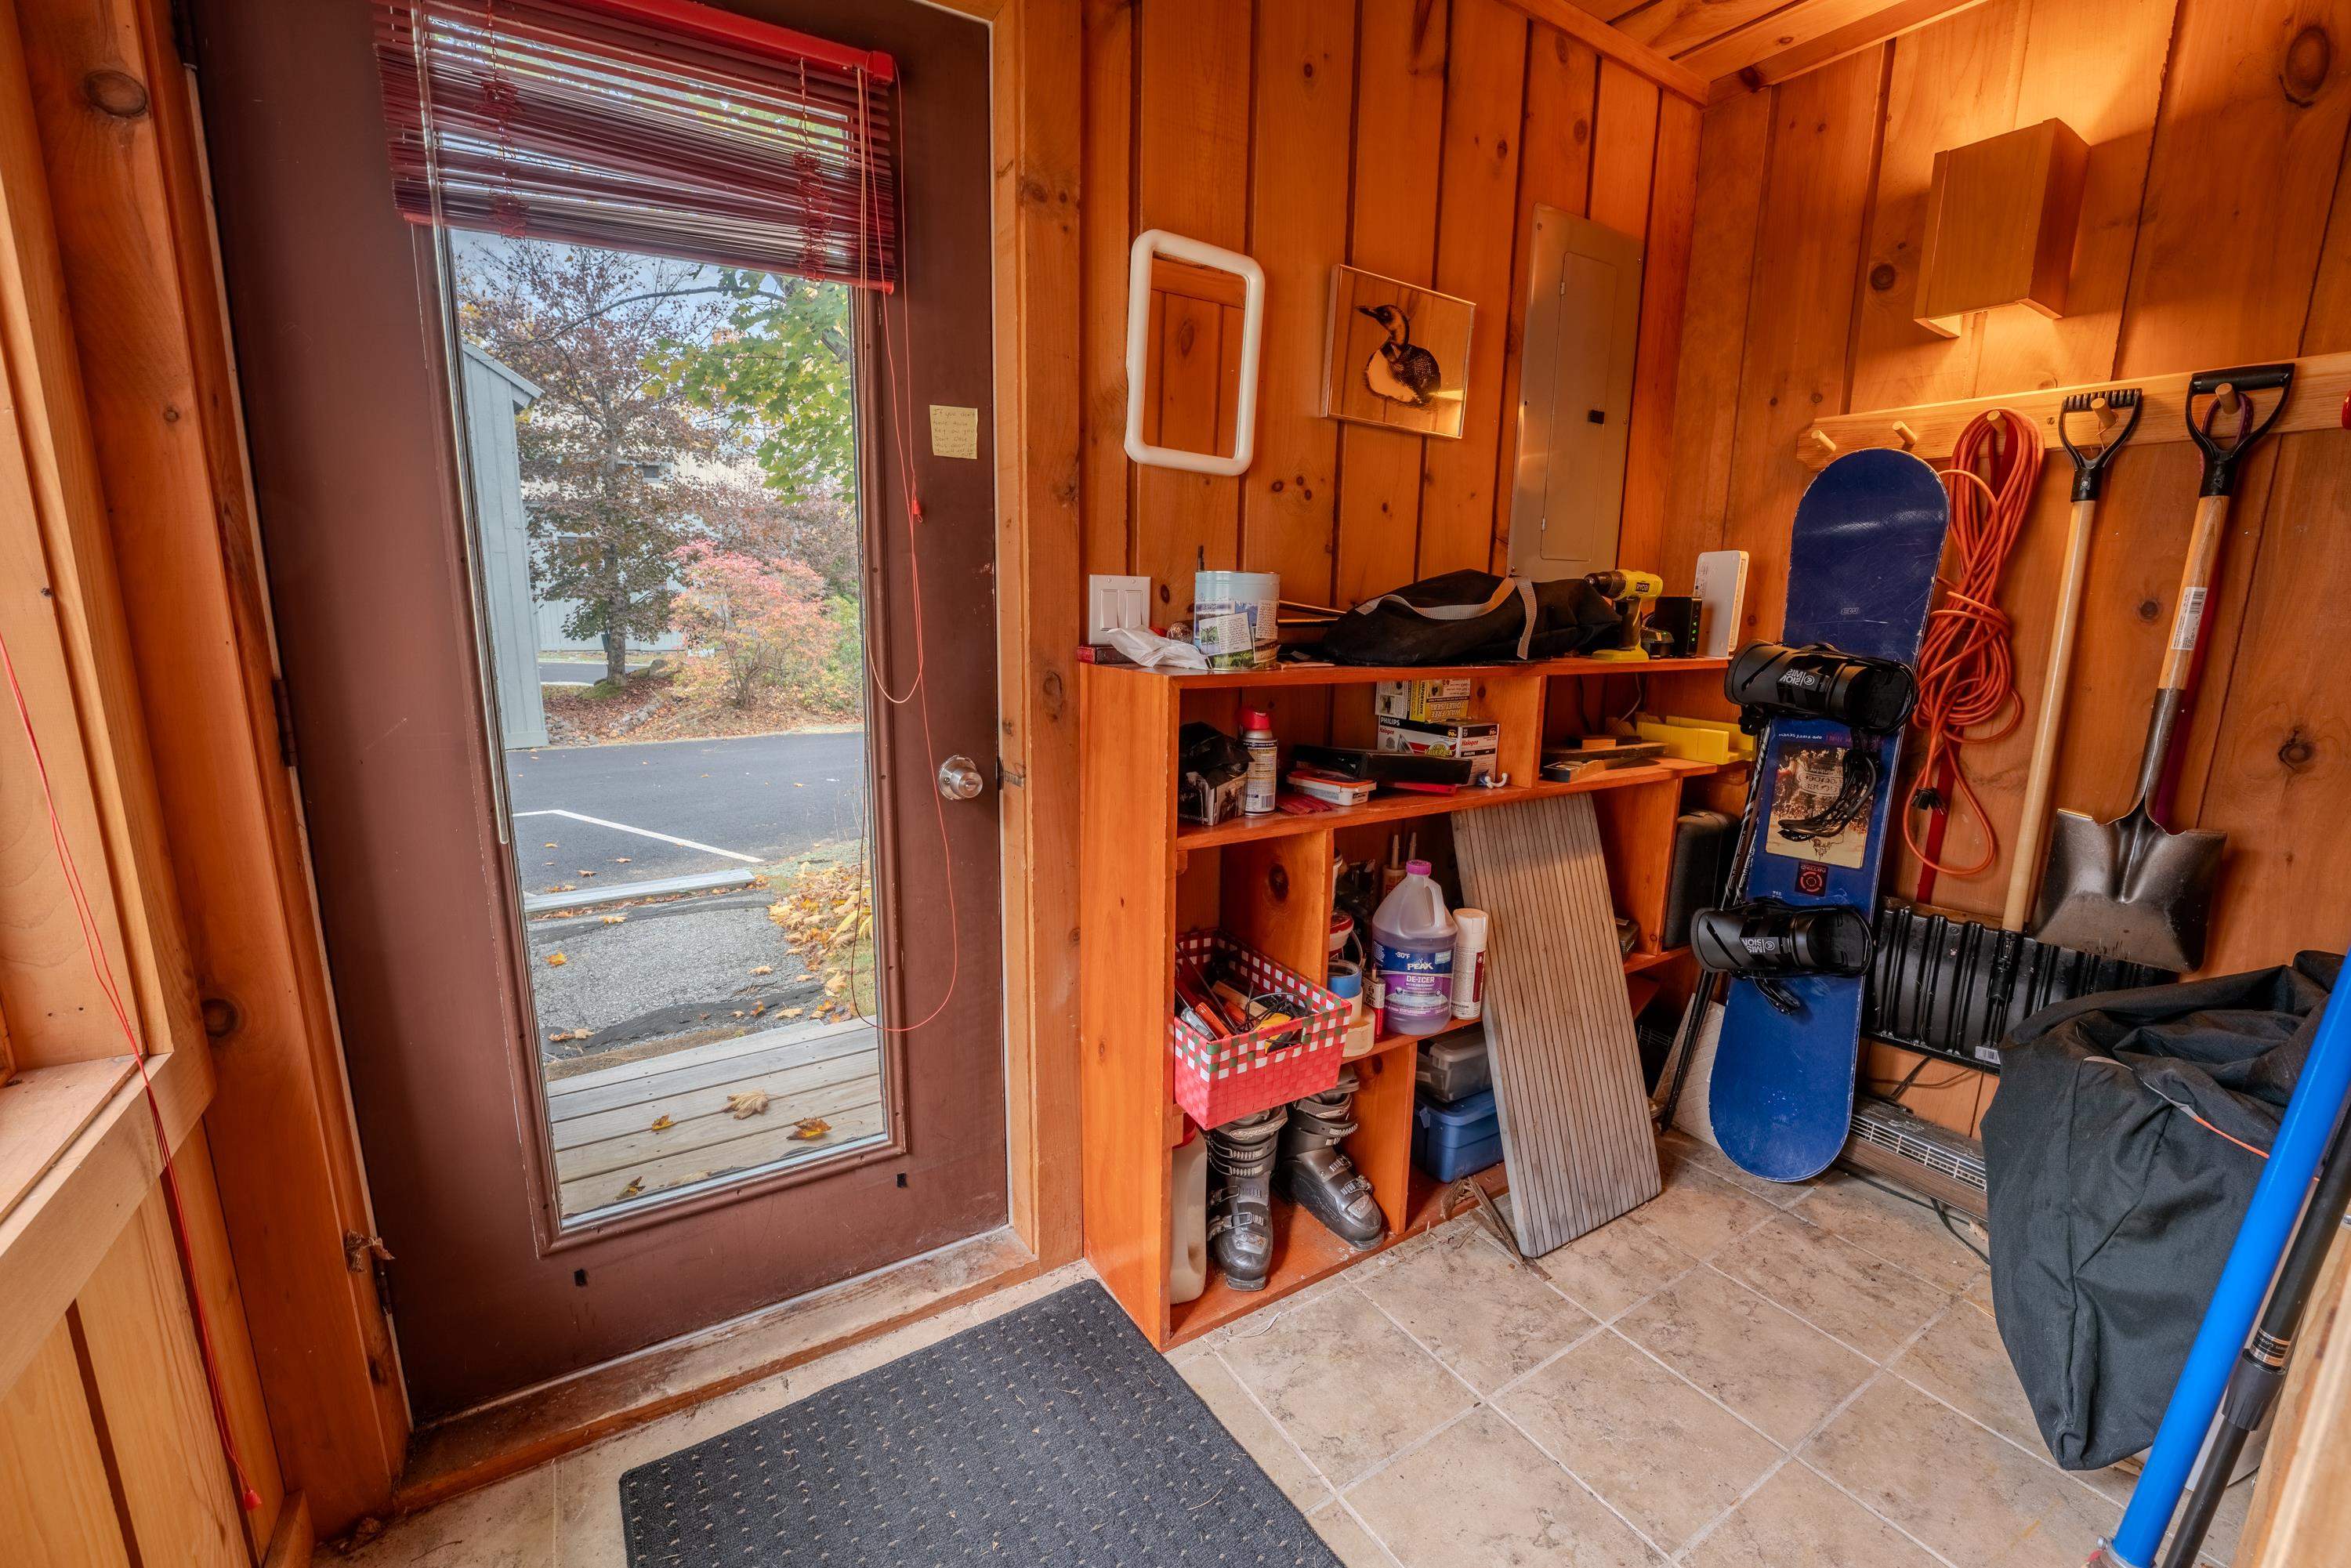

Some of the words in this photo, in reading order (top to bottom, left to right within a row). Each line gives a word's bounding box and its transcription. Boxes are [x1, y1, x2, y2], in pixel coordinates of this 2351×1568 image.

[1636, 582, 1650, 591] RYOBI
[1380, 716, 1400, 726] PHILIPS
[1379, 726, 1395, 735] Halogen
[1407, 961, 1434, 970] PEAK
